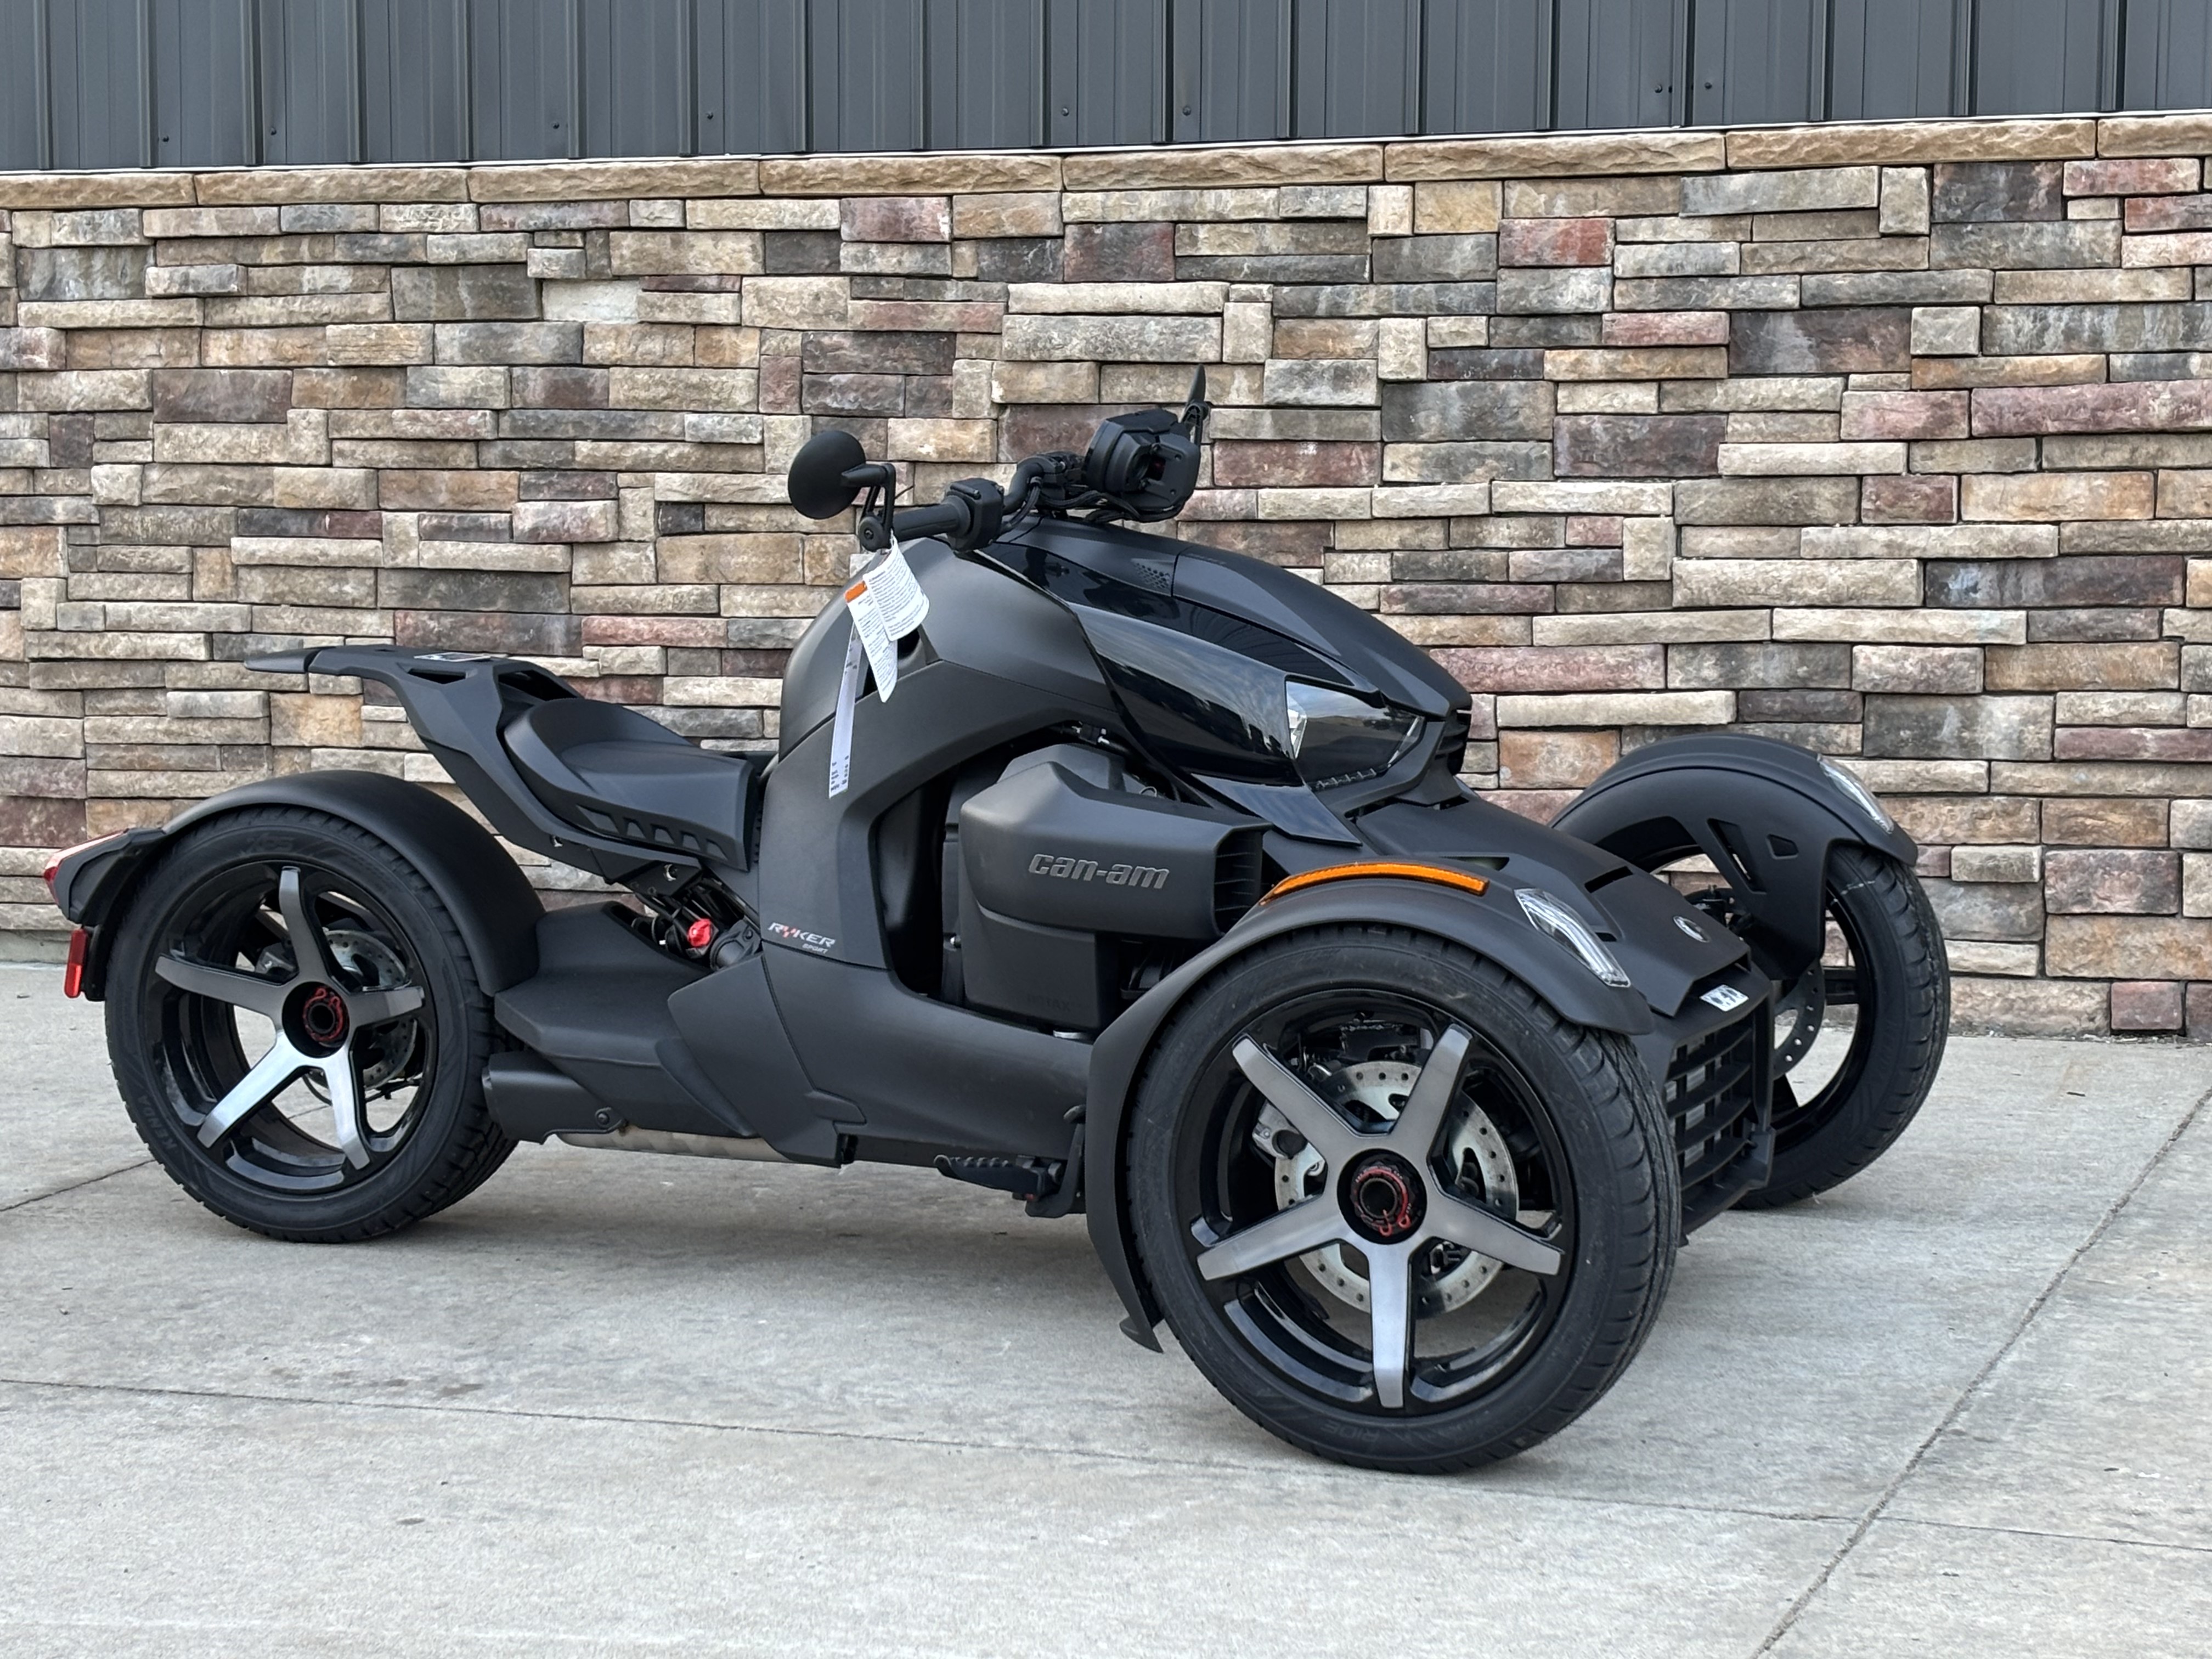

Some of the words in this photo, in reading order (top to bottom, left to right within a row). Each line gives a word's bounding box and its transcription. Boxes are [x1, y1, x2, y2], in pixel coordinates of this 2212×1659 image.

[1029, 854, 1170, 889] can-am
[768, 922, 837, 948] RYKER
[138, 1095, 178, 1149] KENDA
[1319, 1419, 1379, 1443] RIDE
